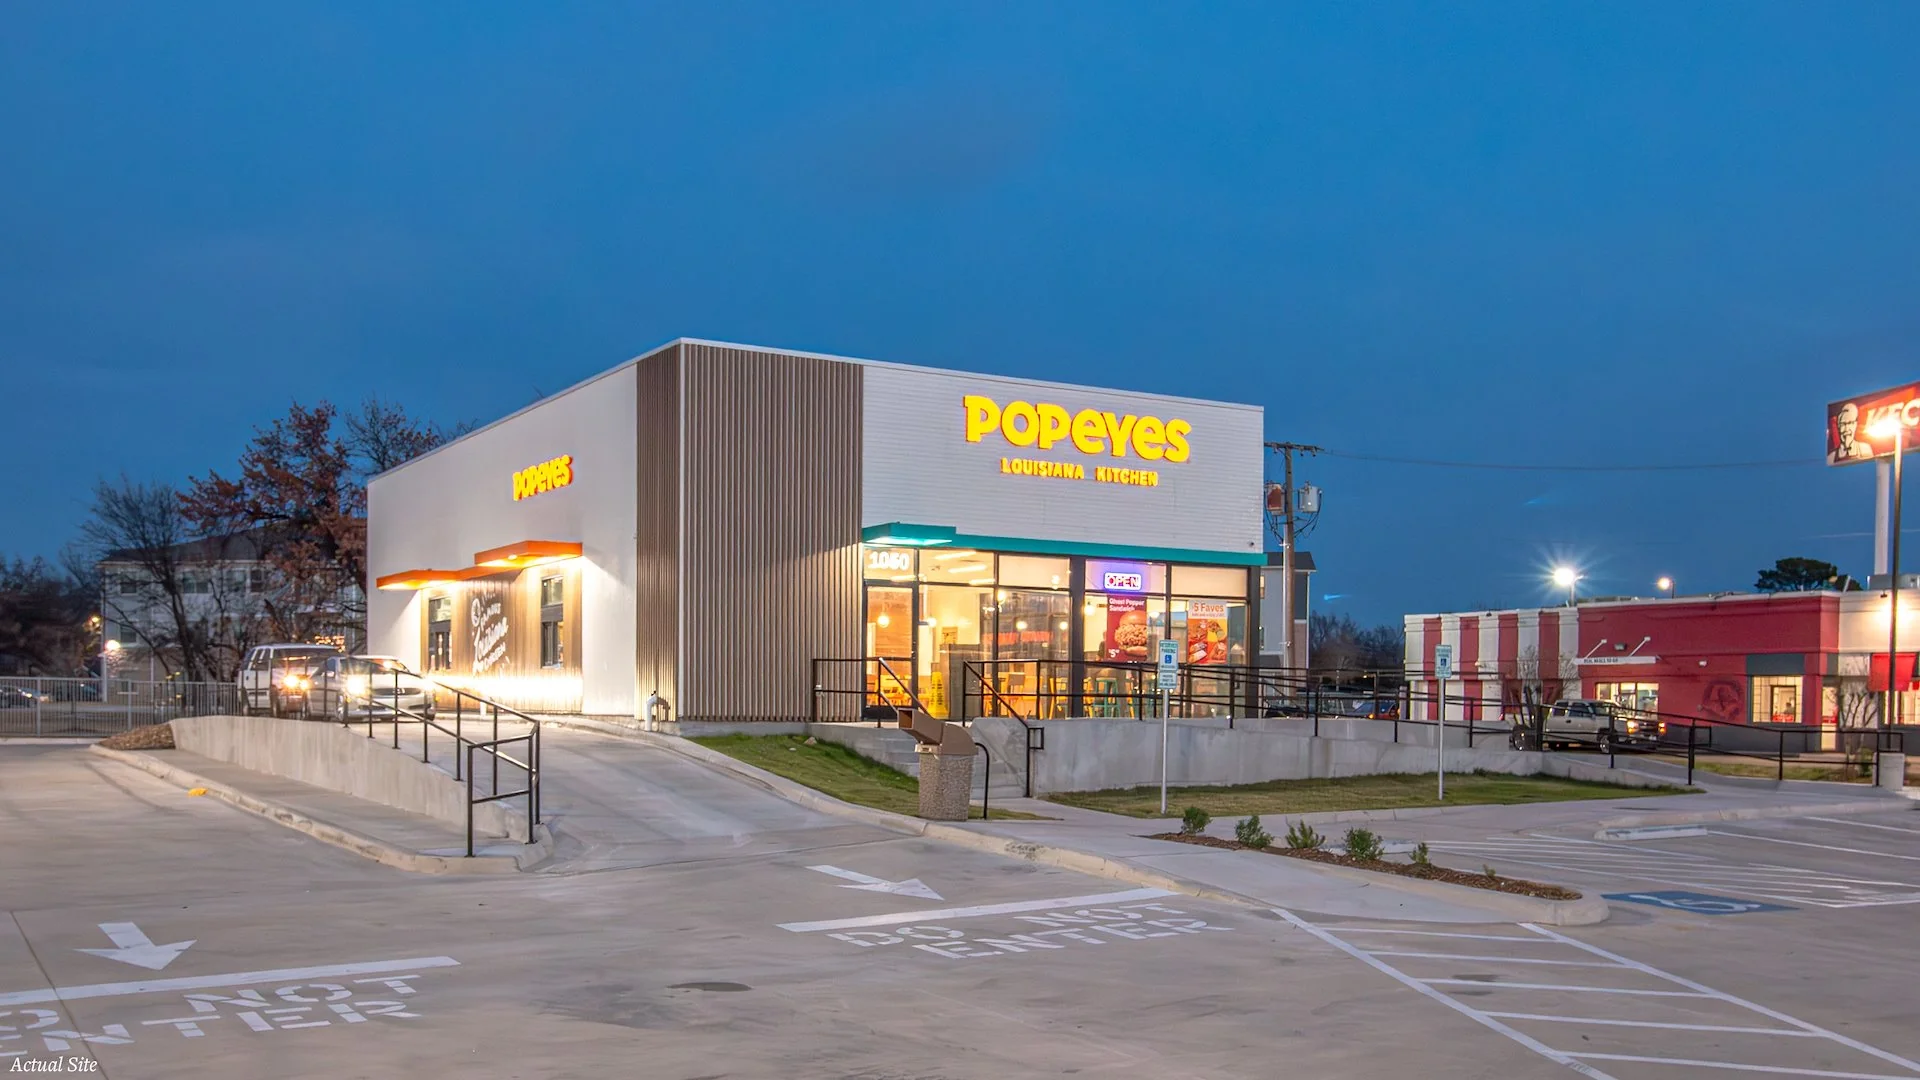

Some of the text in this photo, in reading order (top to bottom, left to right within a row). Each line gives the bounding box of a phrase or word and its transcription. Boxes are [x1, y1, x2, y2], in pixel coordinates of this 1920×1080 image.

[1863, 397, 1920, 434] KFC
[1000, 457, 1159, 487] LOUISIANA KITCHEN
[1106, 574, 1139, 588] OPEN
[1201, 602, 1224, 612] Faves
[826, 903, 1187, 947] DO NOT
[912, 918, 1236, 959] ENTER
[183, 975, 421, 1012] NOT
